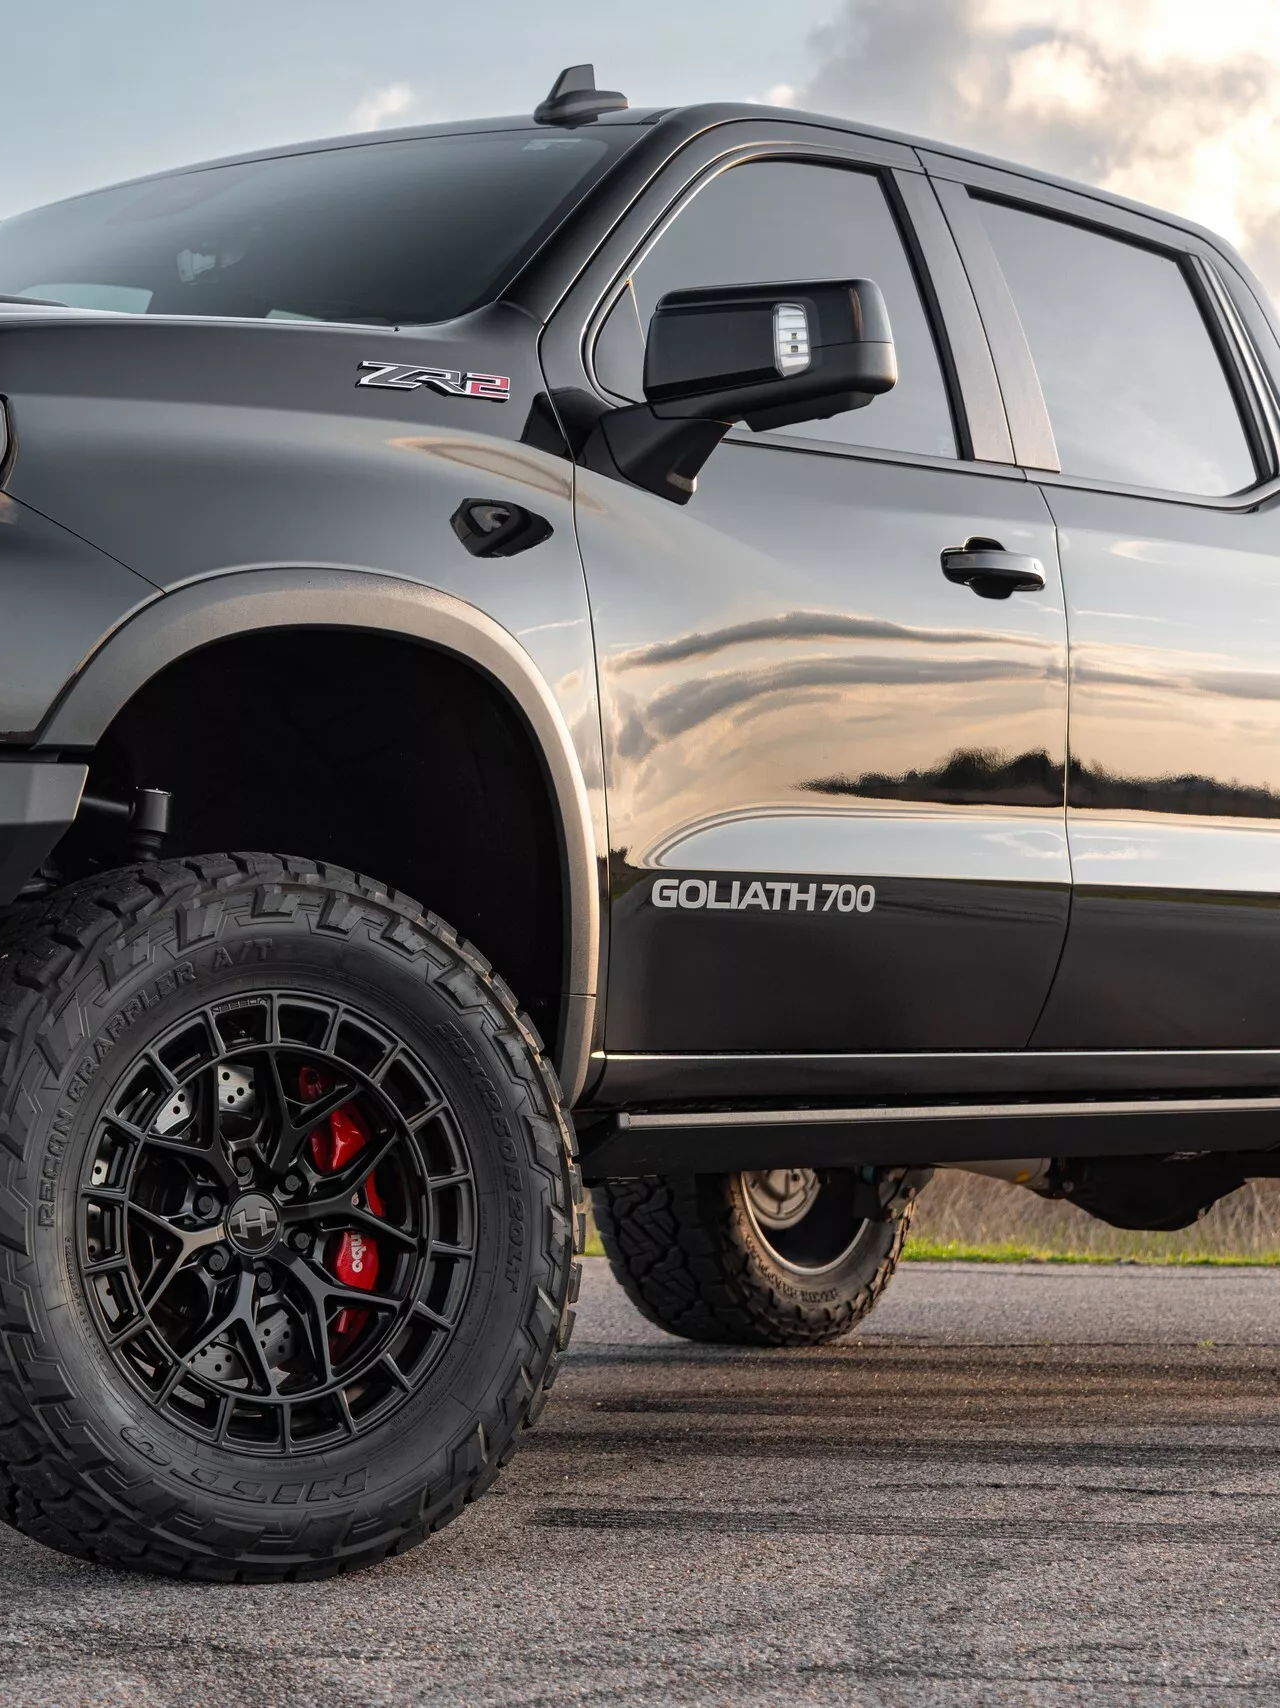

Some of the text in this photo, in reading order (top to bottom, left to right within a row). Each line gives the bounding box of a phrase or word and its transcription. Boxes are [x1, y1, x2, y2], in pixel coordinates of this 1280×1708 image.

[355, 360, 511, 402] ZR2
[651, 878, 876, 913] GOLIATH 700
[38, 1108, 75, 1227] RECON
[67, 960, 198, 1102] GRAPPLER
